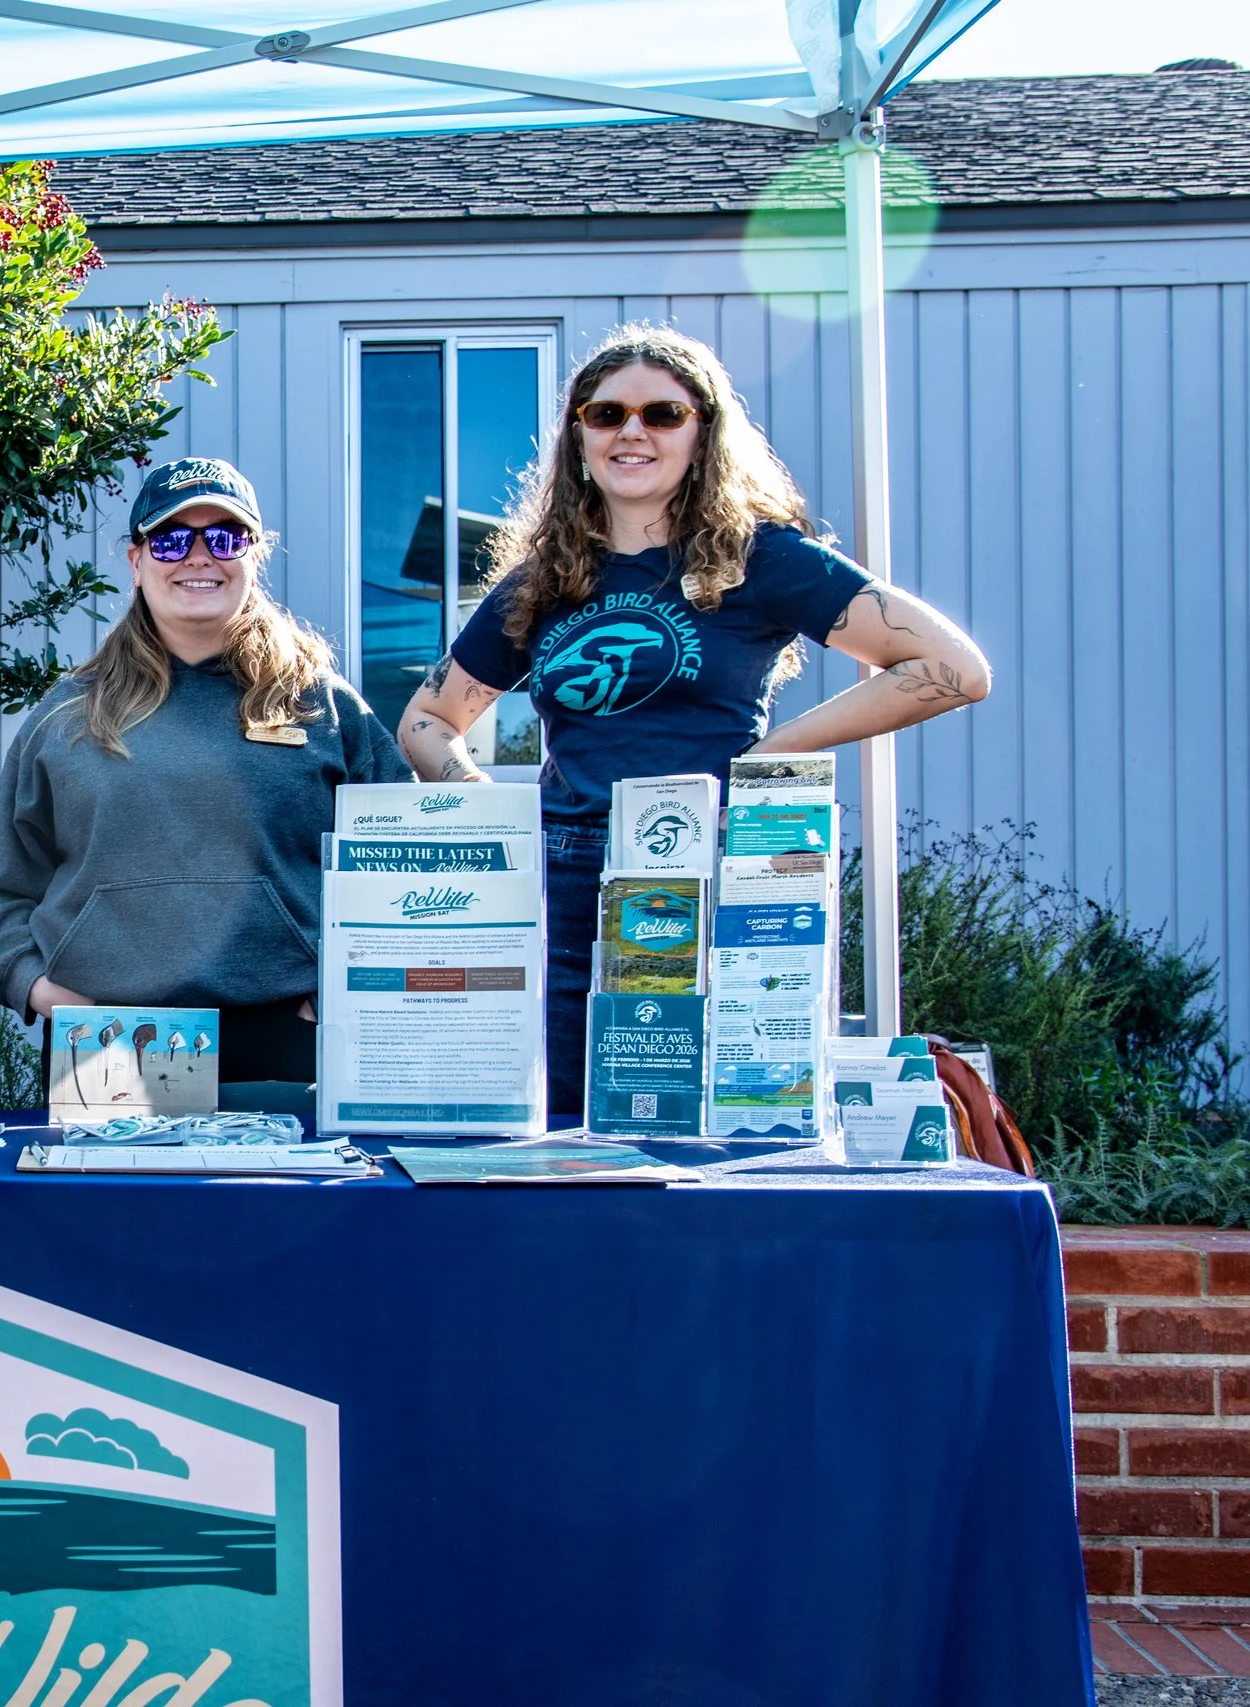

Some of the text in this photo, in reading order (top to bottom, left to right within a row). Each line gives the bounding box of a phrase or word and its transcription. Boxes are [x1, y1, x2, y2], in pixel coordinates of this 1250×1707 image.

[533, 592, 702, 697] SAN DIEGO BIRD ALLIANCE
[414, 793, 468, 809] ReWild
[353, 814, 374, 824] ¿QUÉ
[634, 801, 702, 846] SAN DIEGO BIRD ALLIANCE
[349, 847, 495, 860] MISSED THE LATEST
[356, 862, 399, 872] NEWS
[401, 862, 422, 872] ON
[390, 886, 480, 909] ReWild
[410, 911, 436, 920] MISSION
[627, 918, 691, 935] ReWild
[603, 1033, 693, 1044] FESTIVAL DE AVES
[598, 1043, 698, 1055] DE SAN DIEGO 2026
